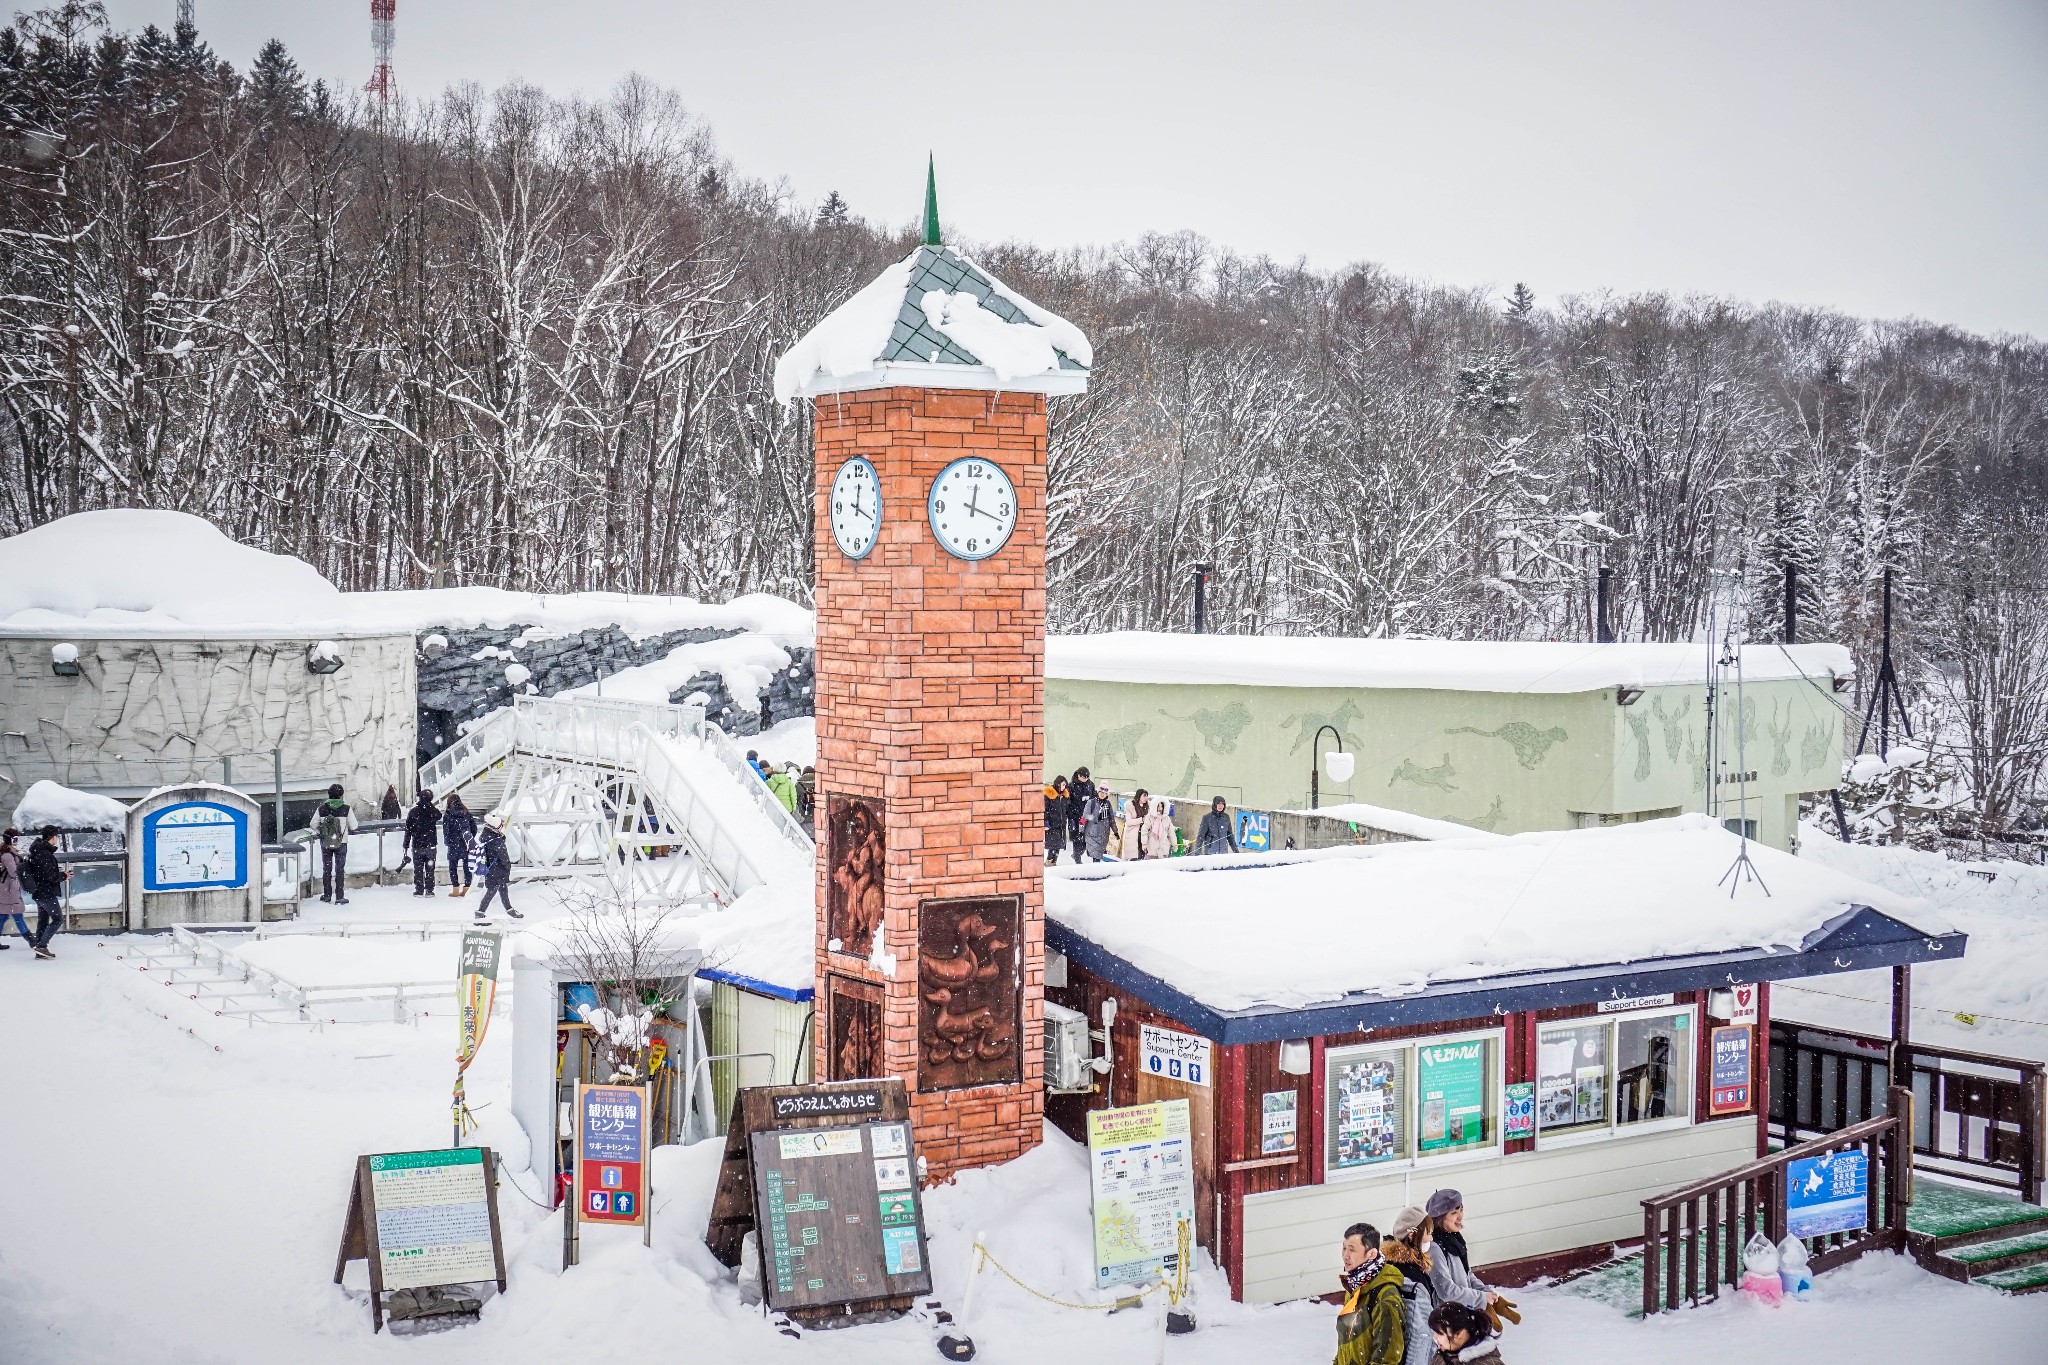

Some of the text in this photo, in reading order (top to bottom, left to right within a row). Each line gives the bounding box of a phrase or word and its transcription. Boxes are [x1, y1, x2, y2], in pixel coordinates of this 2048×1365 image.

[854, 464, 864, 478] 12
[967, 464, 984, 478] 12
[835, 501, 843, 515] 9
[934, 499, 946, 514] 9
[999, 502, 1010, 517] 3
[853, 537, 861, 551] 6
[966, 537, 978, 552] 6
[1248, 814, 1270, 833] 入口
[1604, 997, 1665, 1011] Support Center
[1143, 1027, 1209, 1053] サポートセンター
[1716, 1038, 1747, 1053] 観光情報
[1146, 1041, 1203, 1062] Support Center
[1717, 1051, 1747, 1065] センター
[588, 1103, 637, 1120] 観光情報
[1351, 1105, 1381, 1117] WINTER
[589, 1118, 636, 1133] センター
[588, 1142, 636, 1151] サポートセンター
